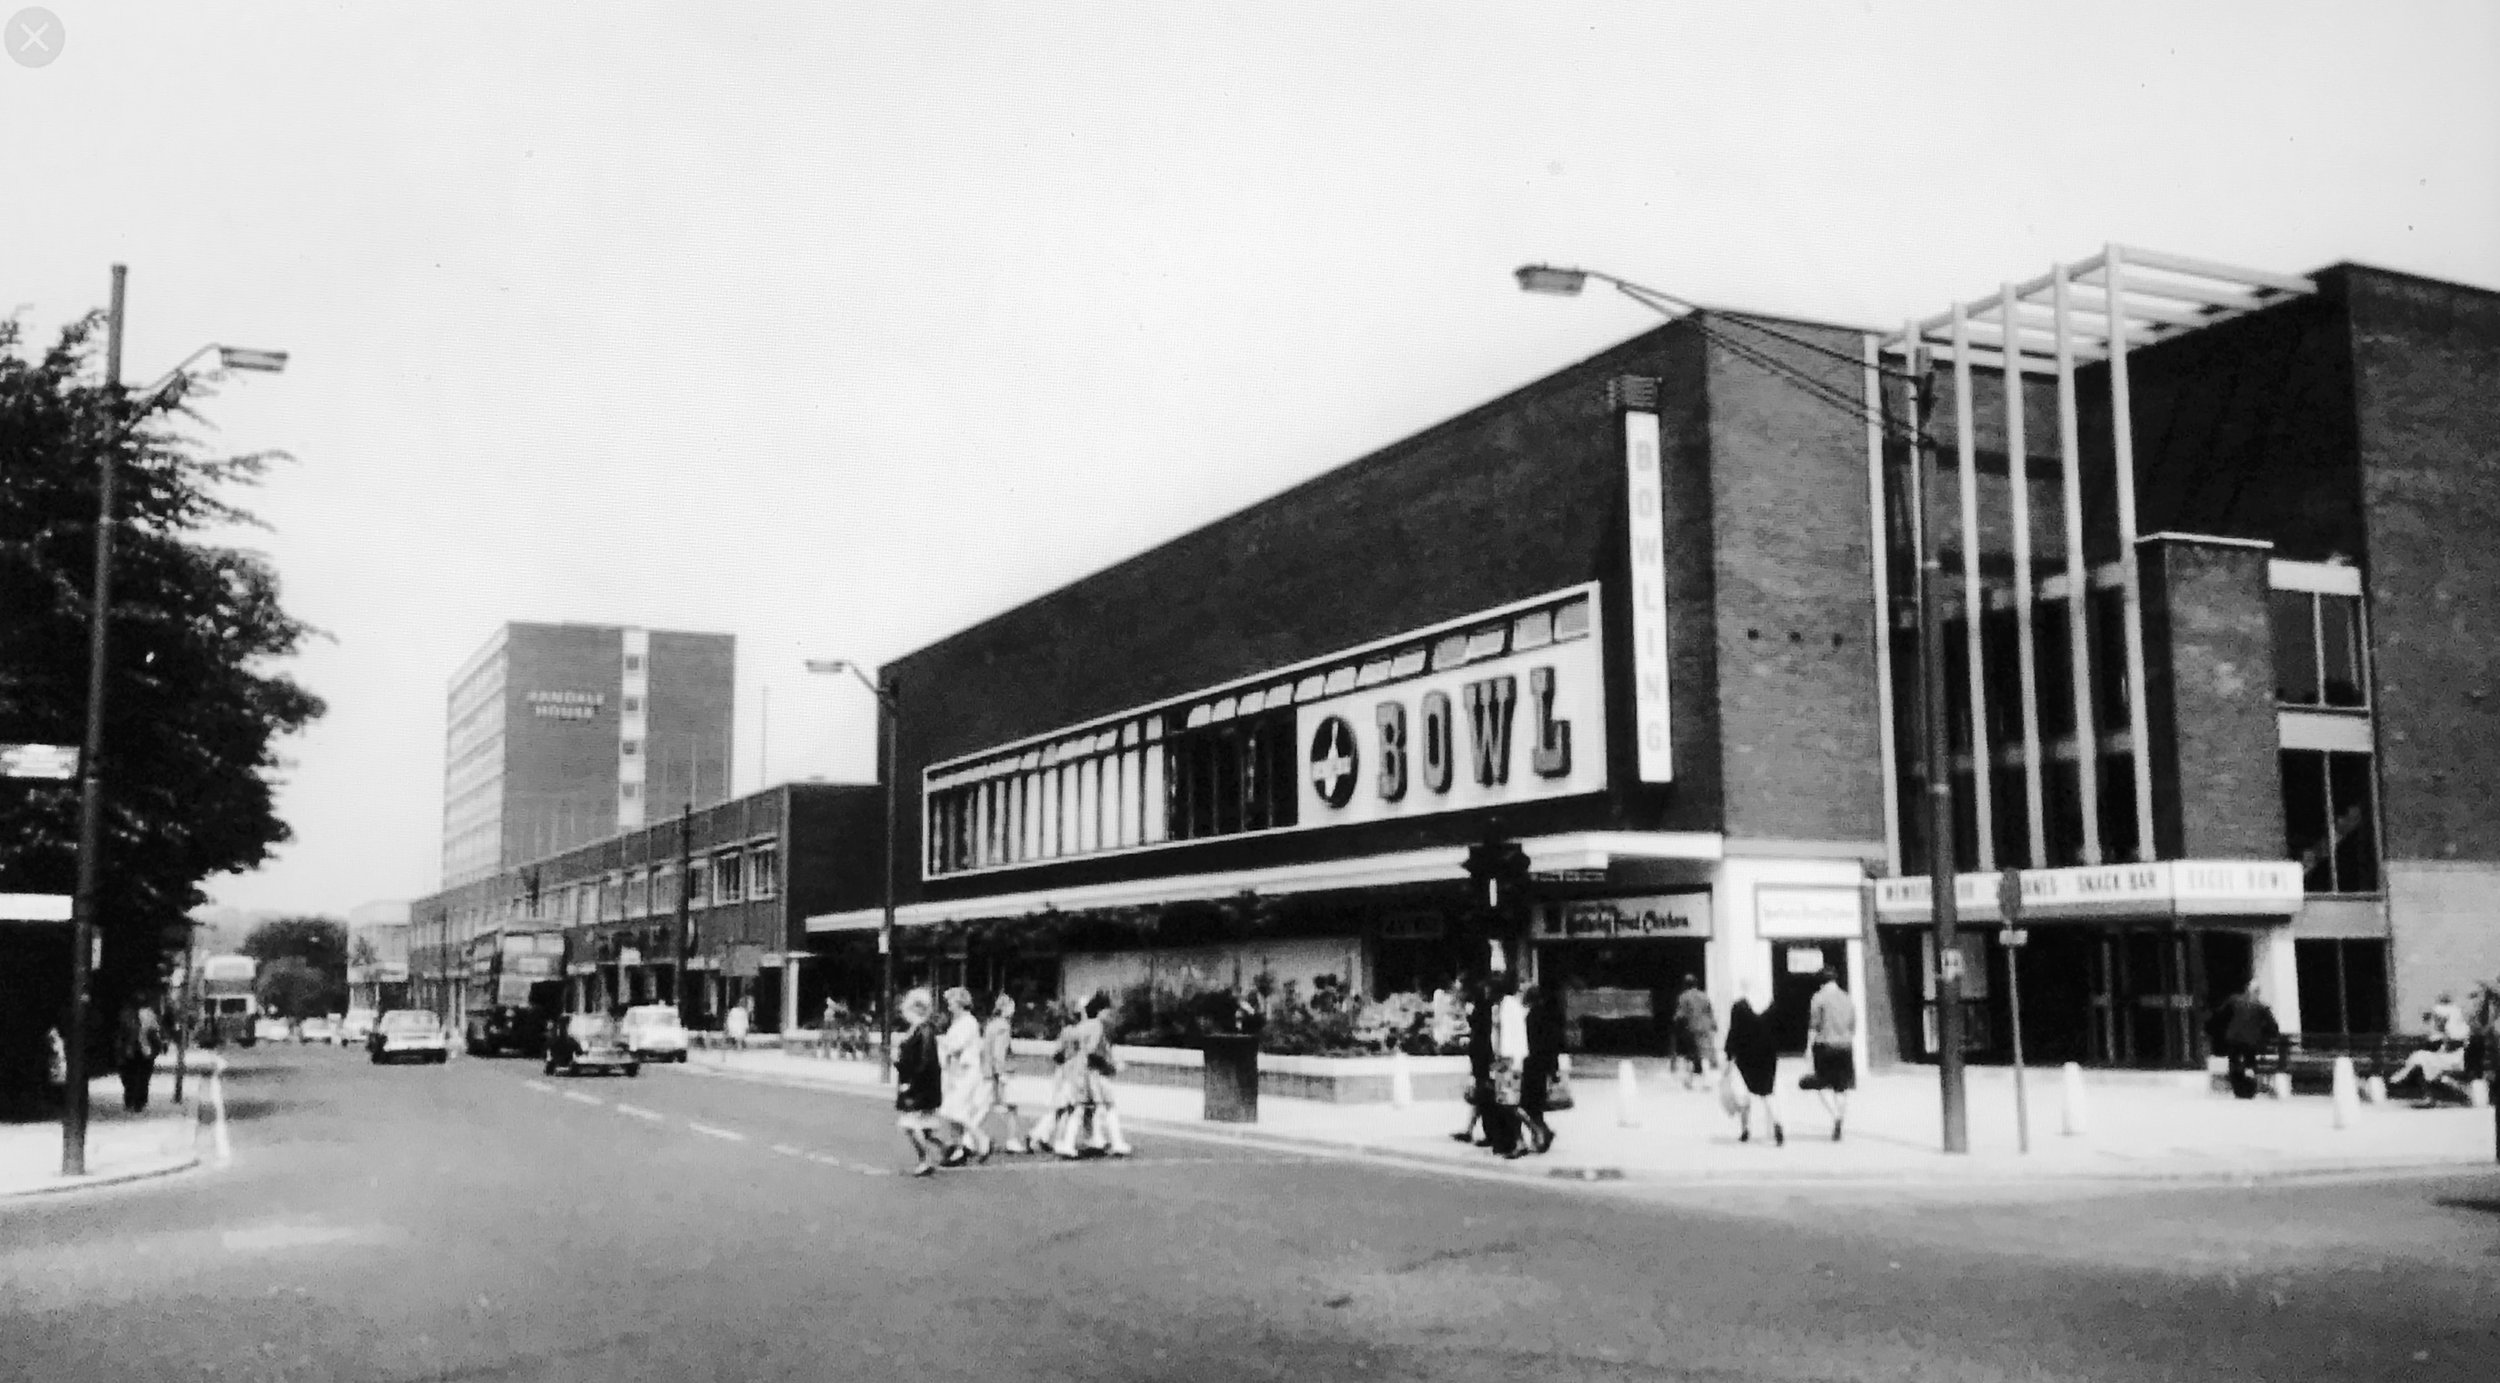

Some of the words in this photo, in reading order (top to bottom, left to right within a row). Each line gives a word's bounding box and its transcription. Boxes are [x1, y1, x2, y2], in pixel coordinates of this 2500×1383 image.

[1634, 440, 1664, 753] BOWLING
[1375, 664, 1572, 804] BOWL
[2078, 873, 2121, 894] SNACK
[2129, 870, 2157, 891] BAR
